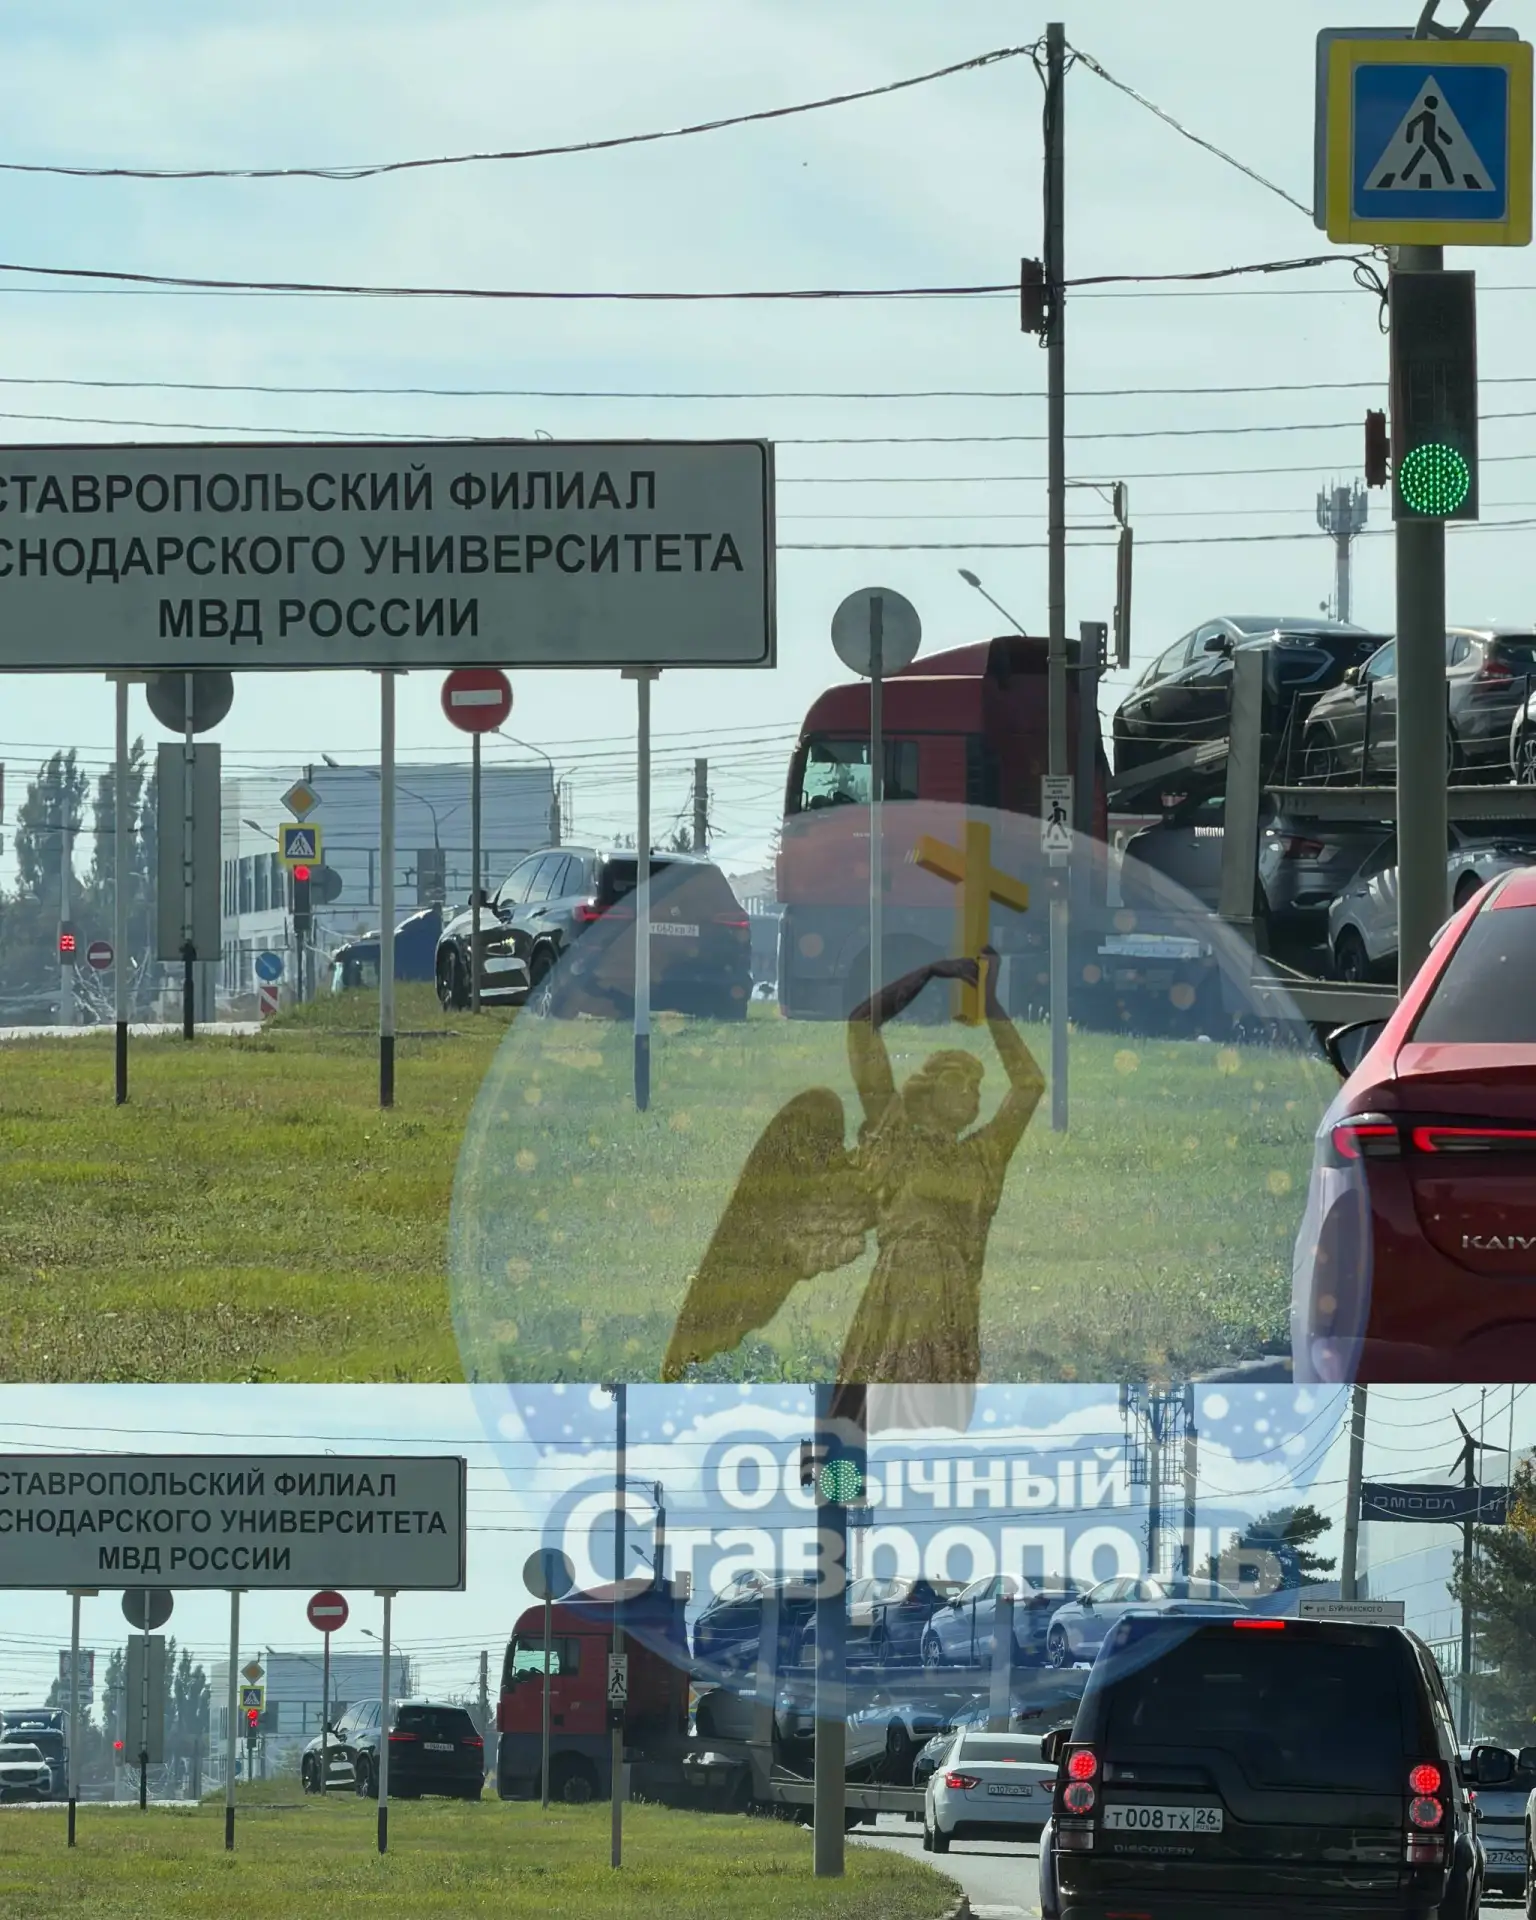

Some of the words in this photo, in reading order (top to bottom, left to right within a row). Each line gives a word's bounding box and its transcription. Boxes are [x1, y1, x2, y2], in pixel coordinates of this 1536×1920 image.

[0, 464, 433, 512] ТАВРОПОЛЬСКИЙ
[449, 470, 657, 511] ФИЛИАЛ
[362, 531, 744, 575] УНИВЕРСИТЕТА
[159, 599, 262, 645] МВД
[278, 598, 479, 639] РОССИИ
[0, 1467, 265, 1496] СТАВРОПОЛЬСКИЙ
[274, 1472, 397, 1497] ФИЛИАЛ
[1373, 1496, 1455, 1510] OMODA
[0, 1509, 211, 1537] СНОДАРСКОГО
[220, 1509, 447, 1534] УНИВЕРСИТЕТА
[98, 1546, 161, 1574] МВД
[170, 1546, 291, 1570] РОССИИ
[1112, 1808, 1190, 1830] Т008ТХ
[1195, 1810, 1216, 1825] 26
[1113, 1844, 1195, 1856] DISCOVERY
